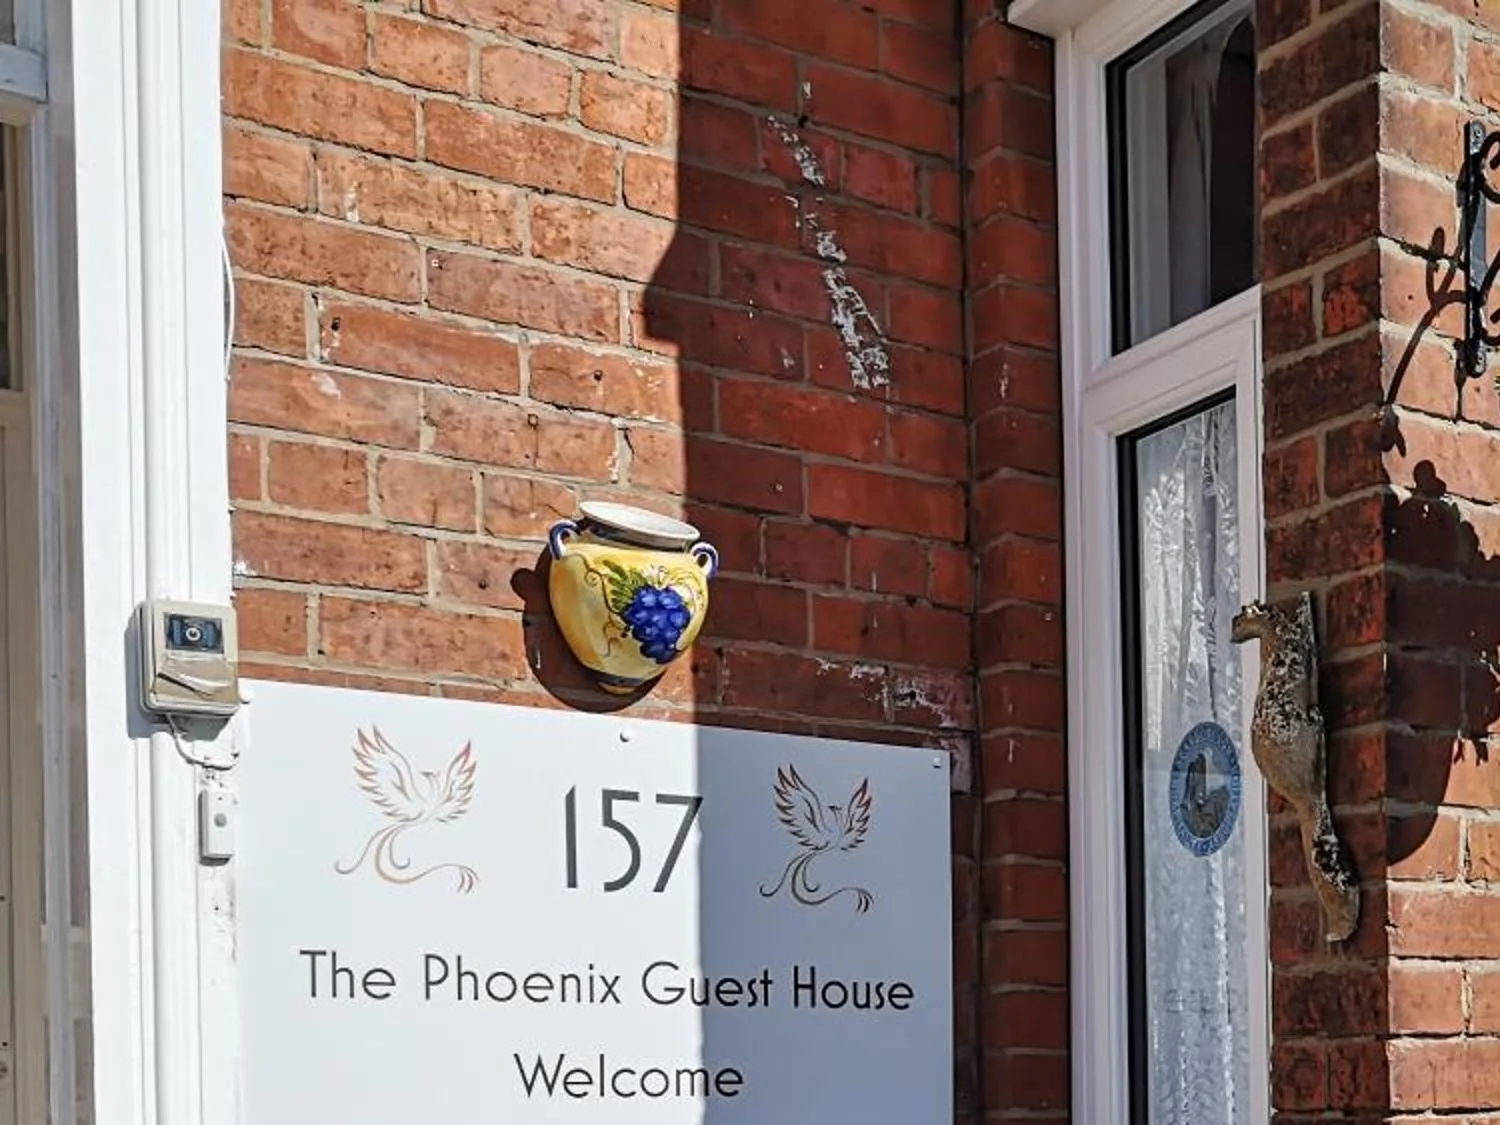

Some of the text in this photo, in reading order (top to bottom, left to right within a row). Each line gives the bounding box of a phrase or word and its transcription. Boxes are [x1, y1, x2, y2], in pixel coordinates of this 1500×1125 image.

[563, 784, 704, 893] 157
[299, 949, 915, 1011] The Phoenix Guest House
[512, 1052, 745, 1098] Welcome
